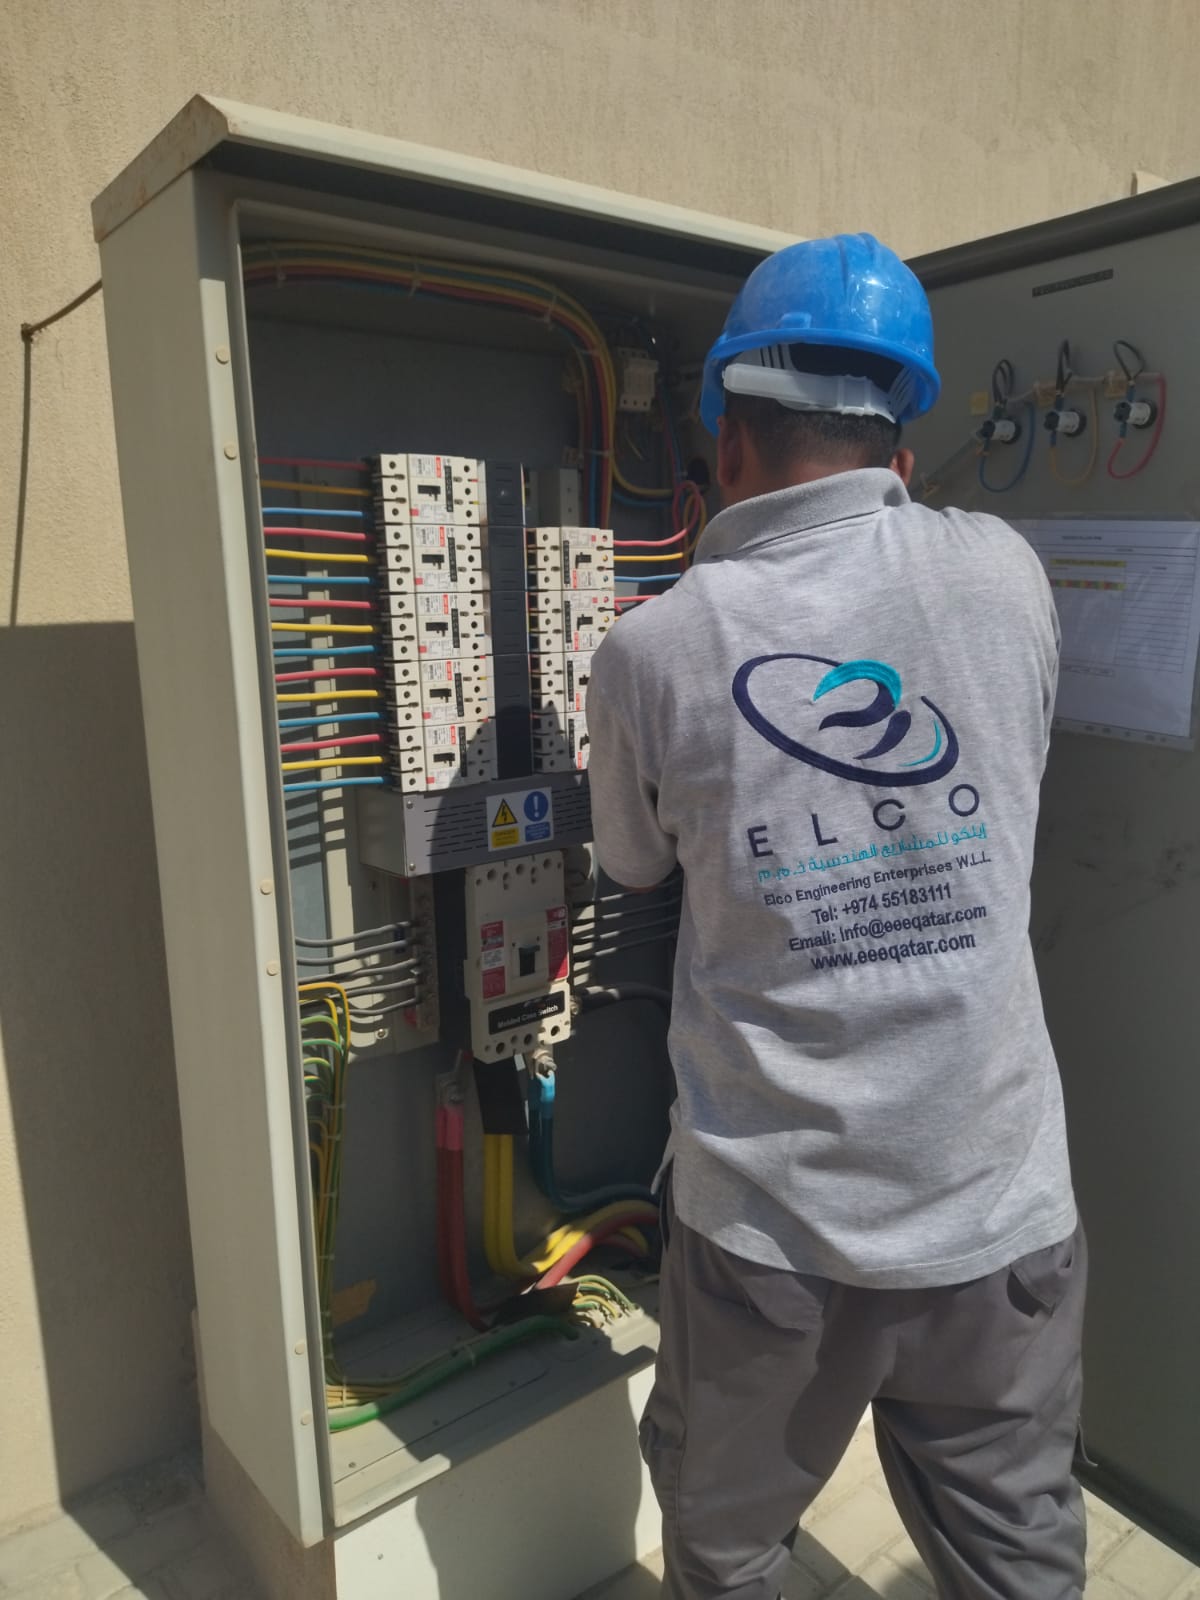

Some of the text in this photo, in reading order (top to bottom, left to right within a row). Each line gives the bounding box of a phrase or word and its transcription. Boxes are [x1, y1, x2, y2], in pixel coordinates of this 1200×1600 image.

[764, 893, 793, 906] Elco
[796, 874, 871, 902] Engineering
[874, 861, 953, 883] Enterprises
[811, 882, 952, 925] Tel: +974 55183111
[789, 930, 837, 951] Email:
[811, 933, 976, 969] www.eeeqatar.com
